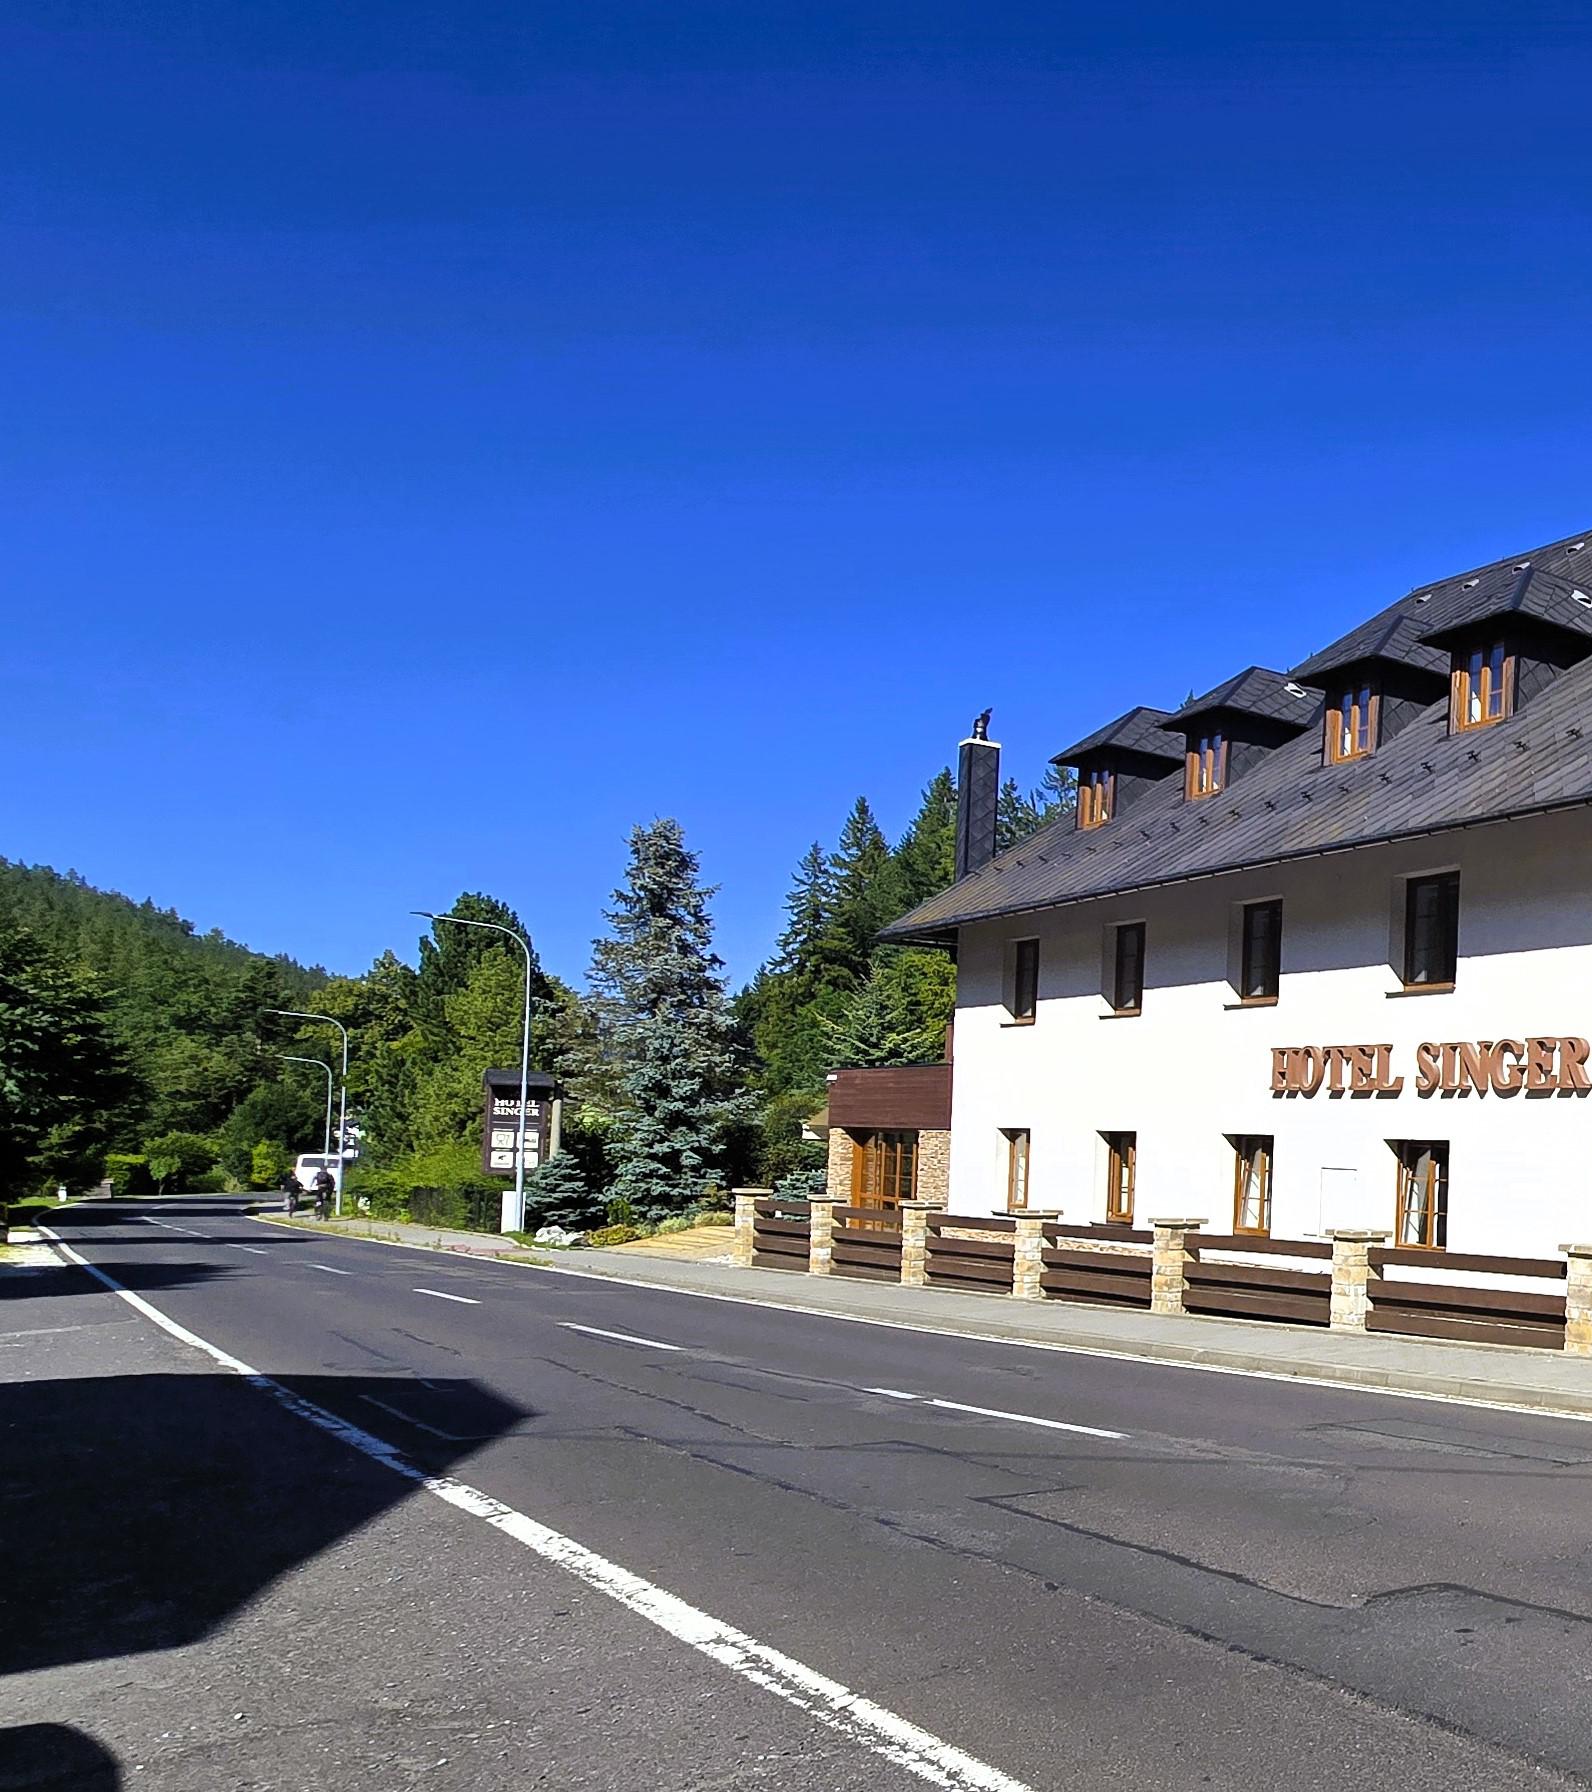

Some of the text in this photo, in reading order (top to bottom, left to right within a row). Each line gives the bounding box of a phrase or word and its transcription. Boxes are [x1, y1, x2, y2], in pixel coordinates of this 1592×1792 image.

[1269, 1037, 1592, 1100] HOTEL SINGER
[493, 1107, 540, 1117] SINGER
